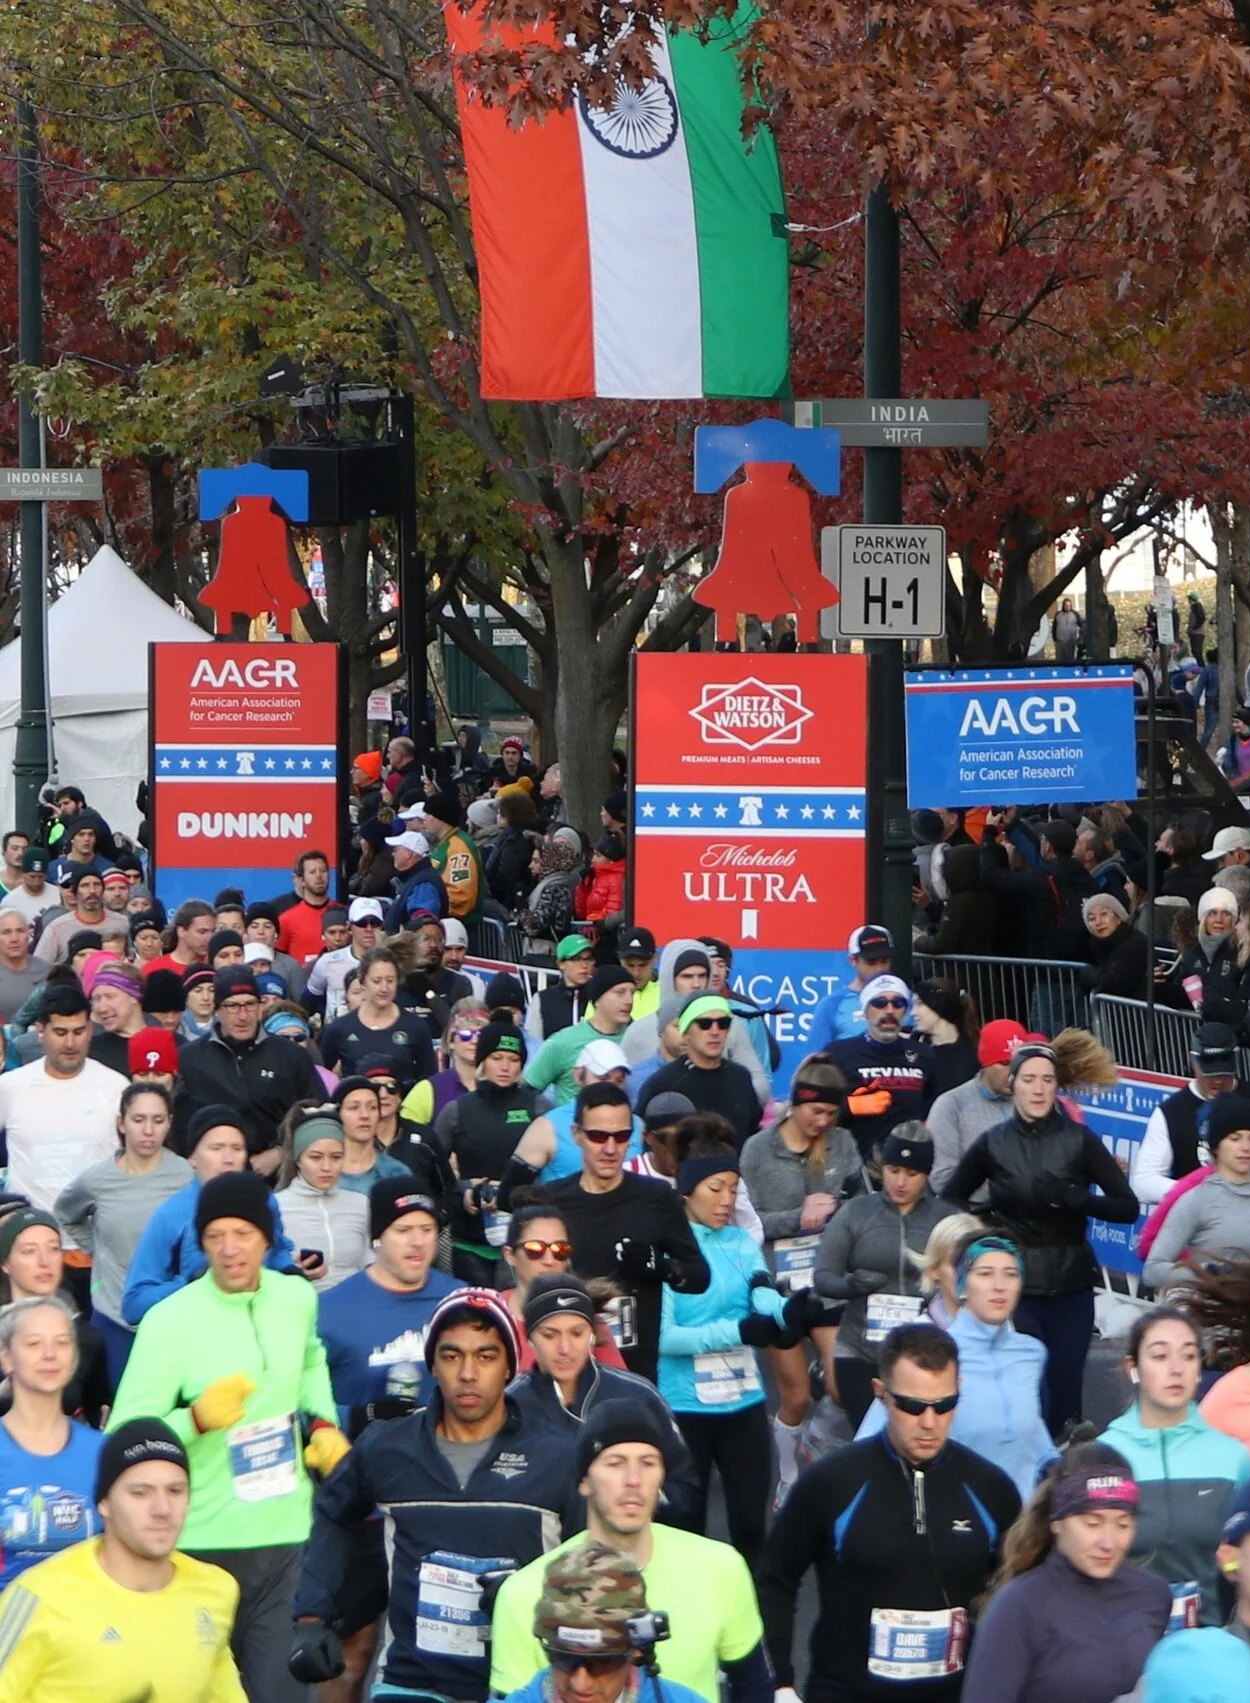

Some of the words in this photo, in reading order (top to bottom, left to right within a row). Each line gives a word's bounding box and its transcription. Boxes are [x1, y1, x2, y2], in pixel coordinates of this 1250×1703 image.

[871, 406, 930, 422] INDIA
[883, 427, 923, 444] भारत
[7, 472, 84, 484] INDONESIA
[855, 536, 927, 549] PARKWAY
[852, 552, 930, 565] LOCATION
[863, 576, 919, 626] H-1
[190, 658, 299, 688] AACR
[190, 697, 239, 708] American
[242, 697, 300, 708] Association
[724, 695, 770, 712] DIETZ
[772, 697, 785, 712] &
[190, 710, 205, 721] for
[207, 711, 242, 721] Cancer
[246, 711, 293, 721] Research
[713, 711, 786, 728] WATSON
[958, 695, 1081, 737] AACR
[681, 755, 718, 764] PREMIUM
[719, 755, 746, 764] MEATS
[750, 755, 785, 765] ARTISAN
[786, 756, 821, 765] CHEESES
[959, 748, 1014, 763] American
[1017, 746, 1084, 762] Association
[959, 768, 976, 782] for
[979, 767, 1019, 781] Cancer
[1022, 765, 1075, 779] Research
[177, 811, 313, 839] DUNKIN'
[700, 843, 798, 868] Michelob
[682, 871, 817, 903] ULTRA
